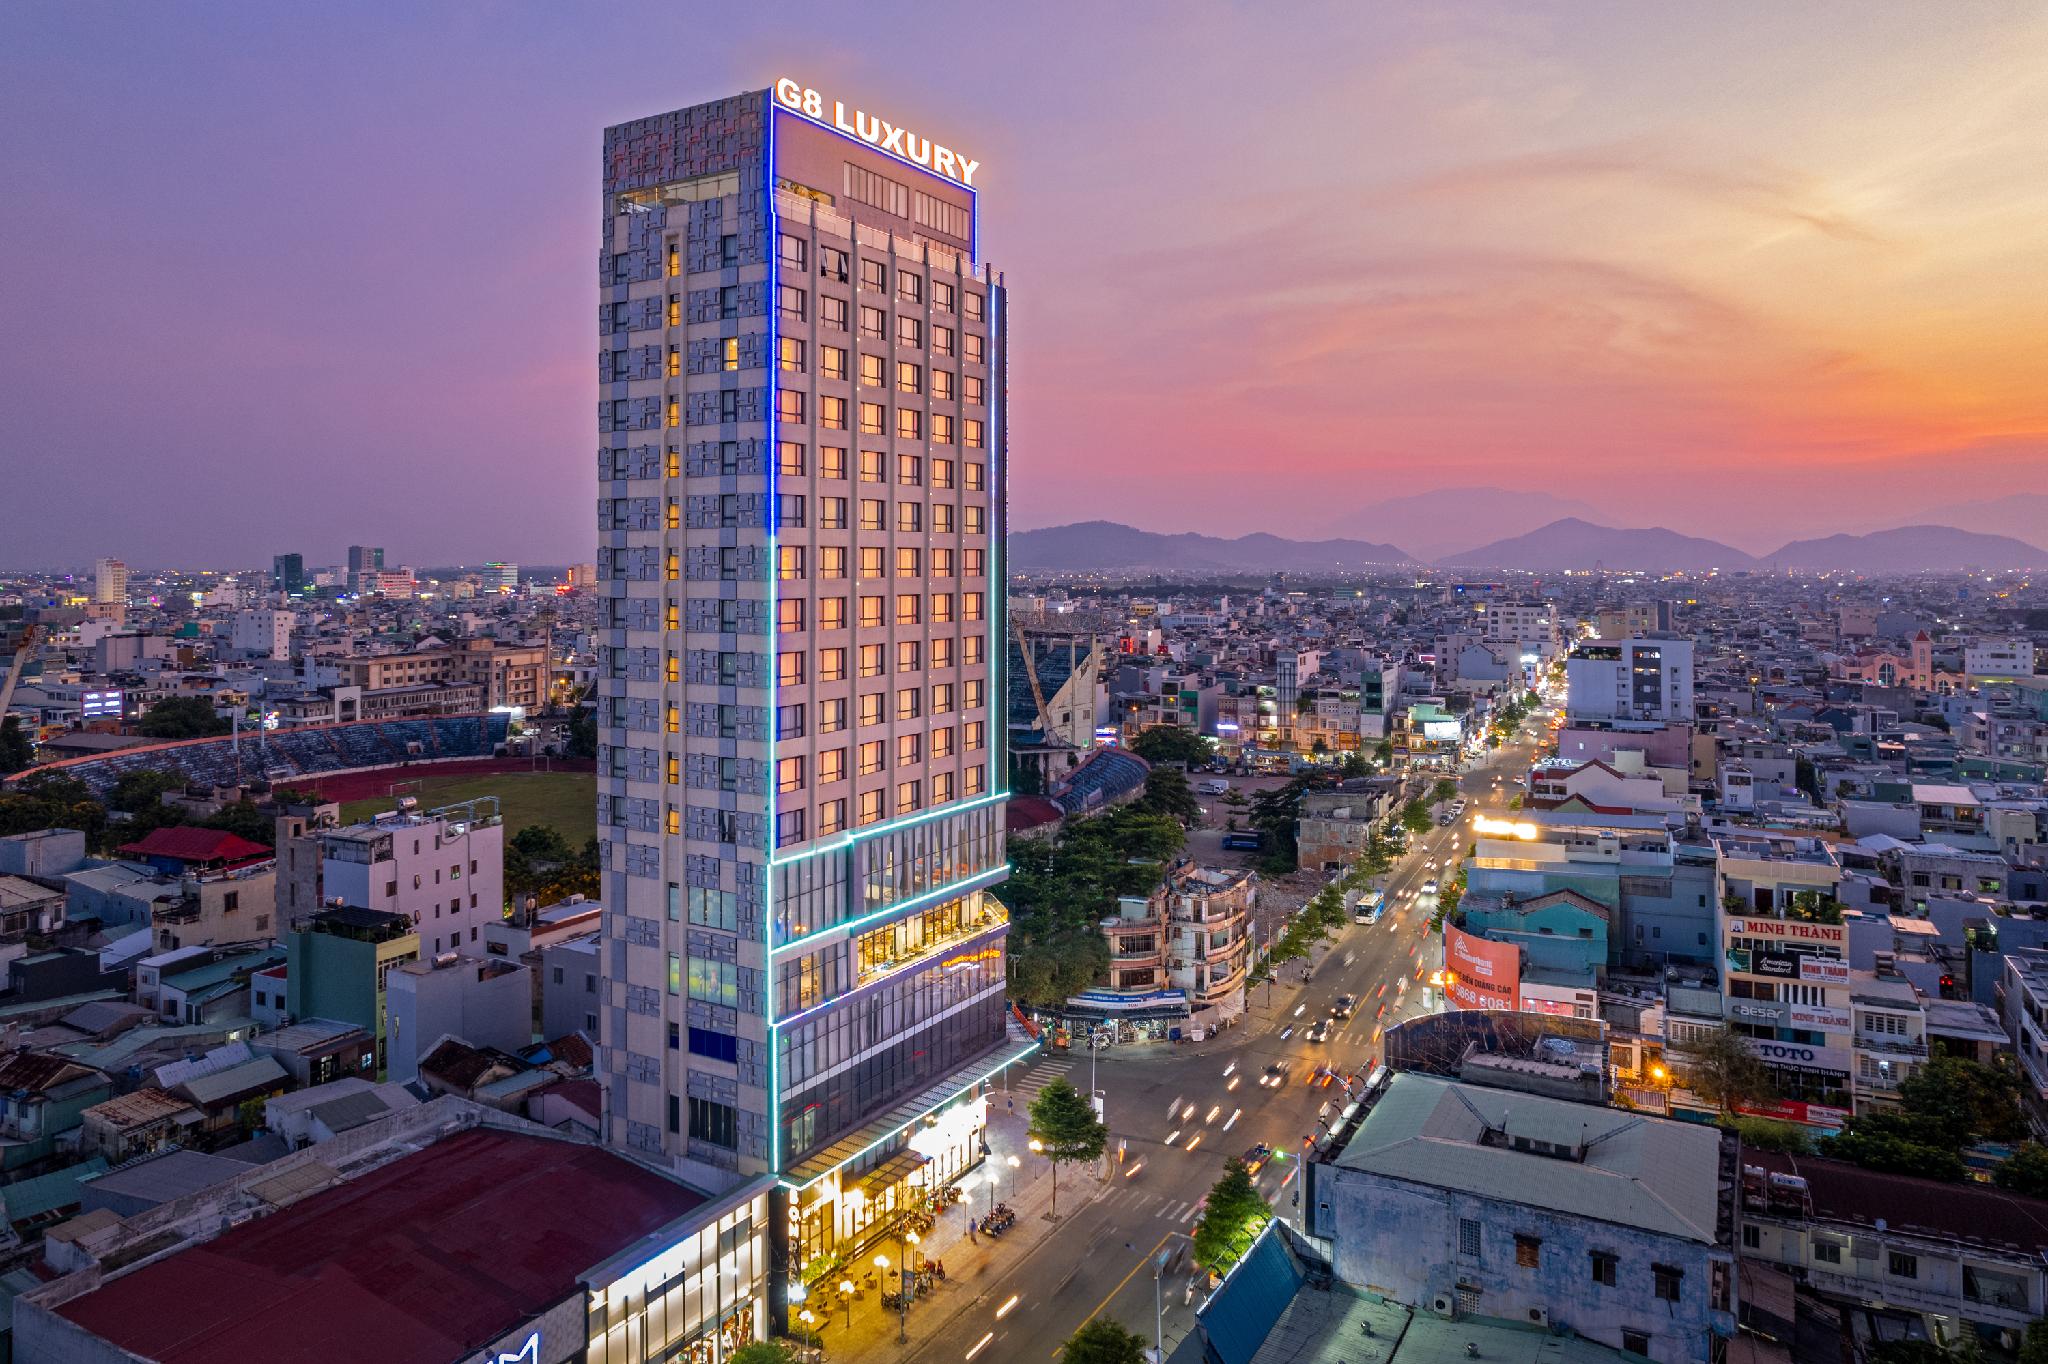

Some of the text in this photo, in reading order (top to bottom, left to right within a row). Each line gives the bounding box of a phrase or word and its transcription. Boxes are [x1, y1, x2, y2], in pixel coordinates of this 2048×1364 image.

[775, 77, 980, 187] G8 LUXURY
[1747, 922, 1842, 940] MINH THÀNH
[1760, 957, 1793, 967] American
[1760, 964, 1792, 974] Standard
[1760, 1045, 1814, 1061] TOTO
